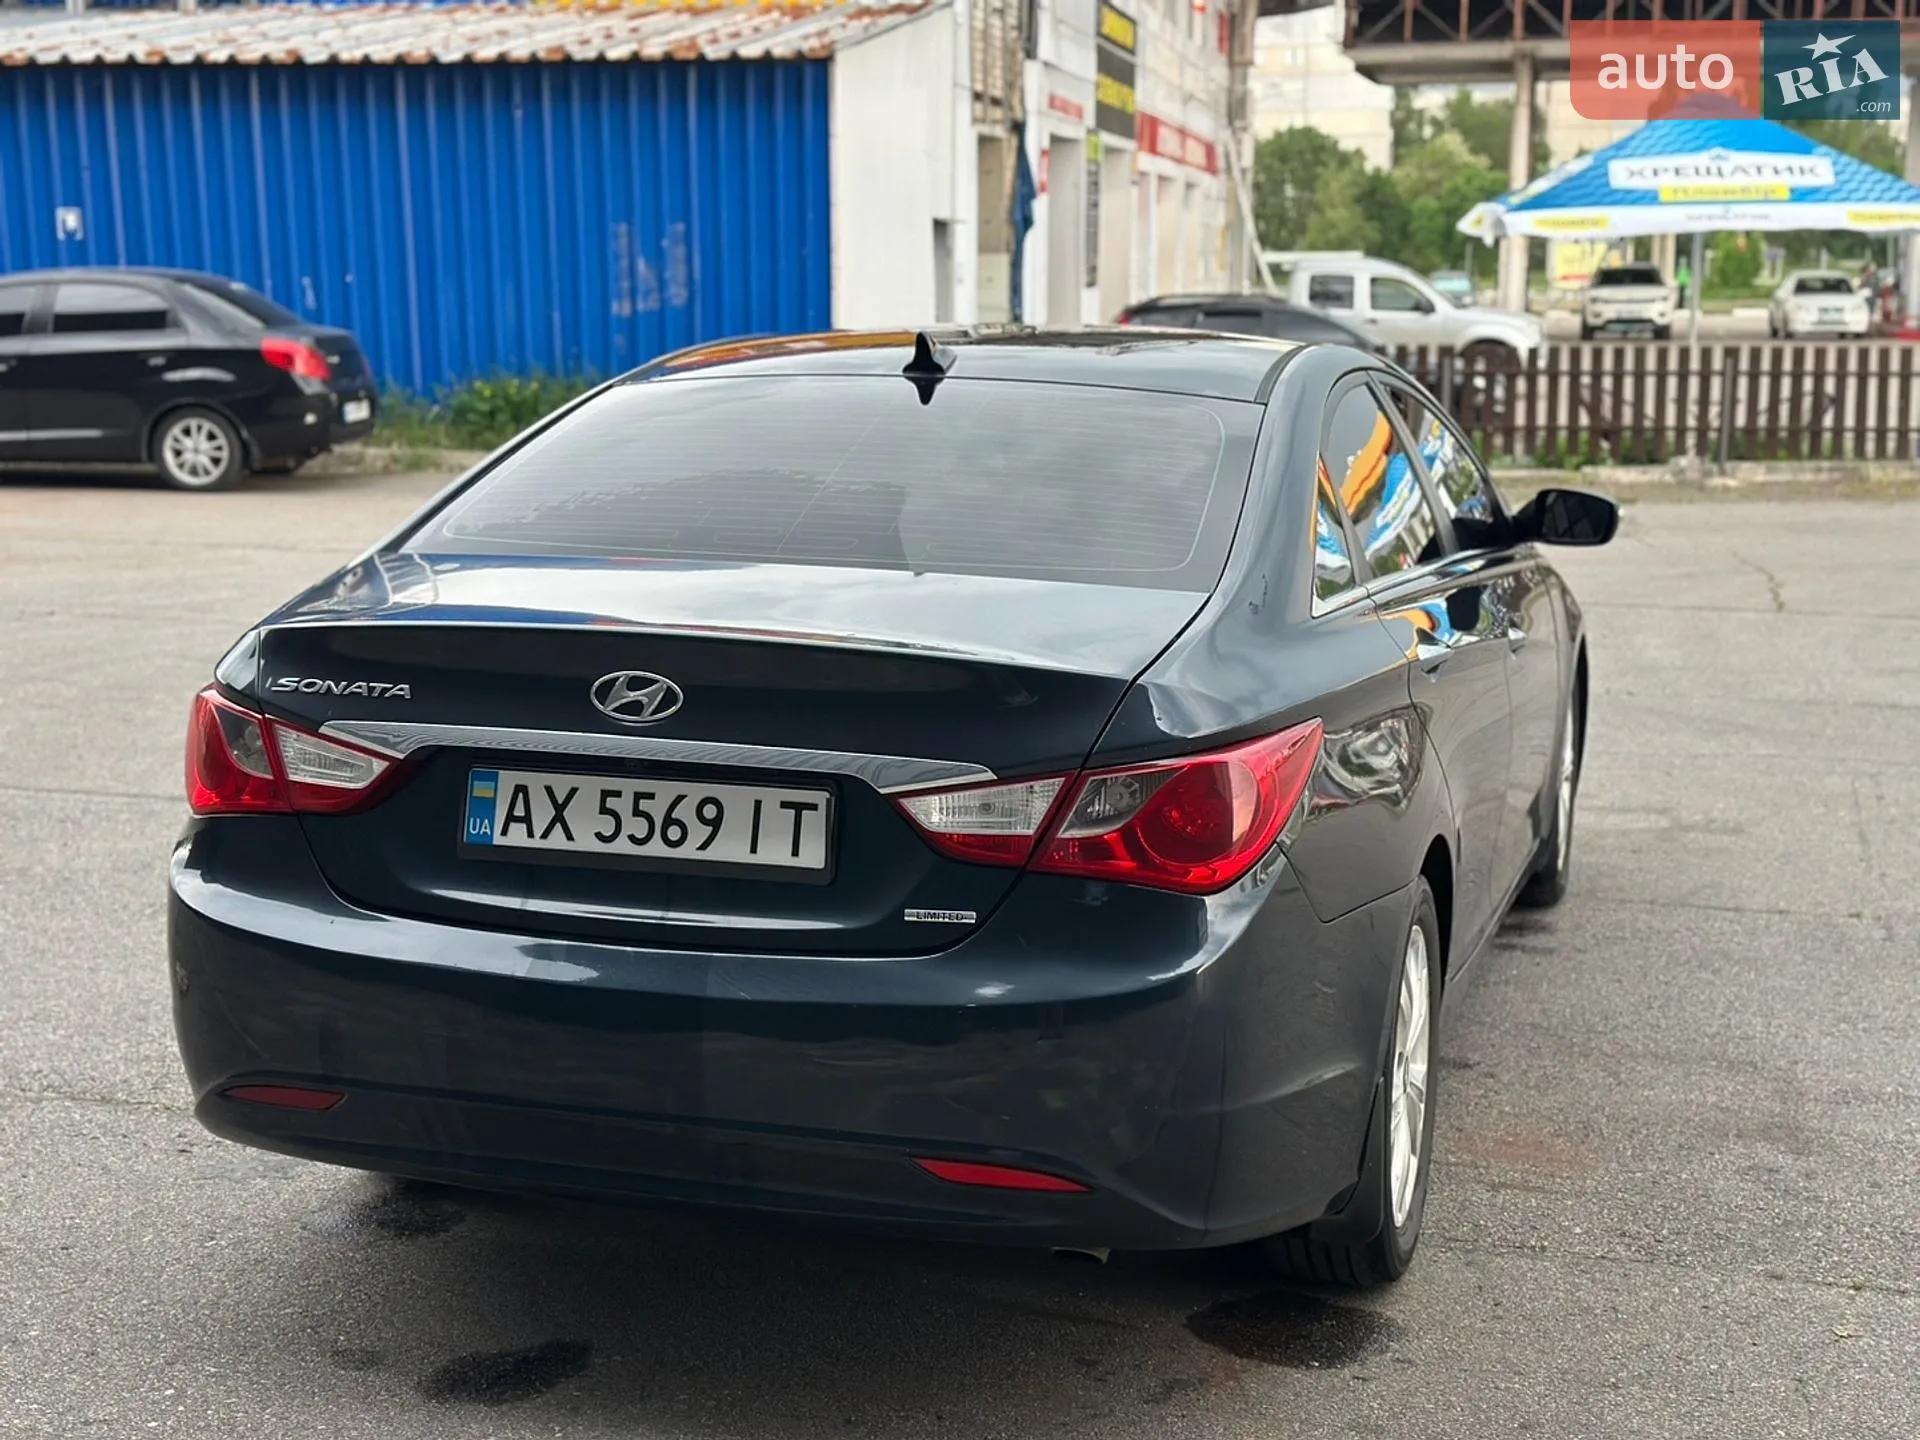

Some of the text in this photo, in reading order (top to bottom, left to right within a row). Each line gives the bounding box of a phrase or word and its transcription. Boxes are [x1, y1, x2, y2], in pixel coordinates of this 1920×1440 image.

[1626, 164, 1822, 180] ХРЕЩАТИК
[270, 676, 413, 700] SONATA
[468, 817, 492, 836] UA
[593, 787, 725, 852] 5569
[914, 910, 965, 922] LIMITED
